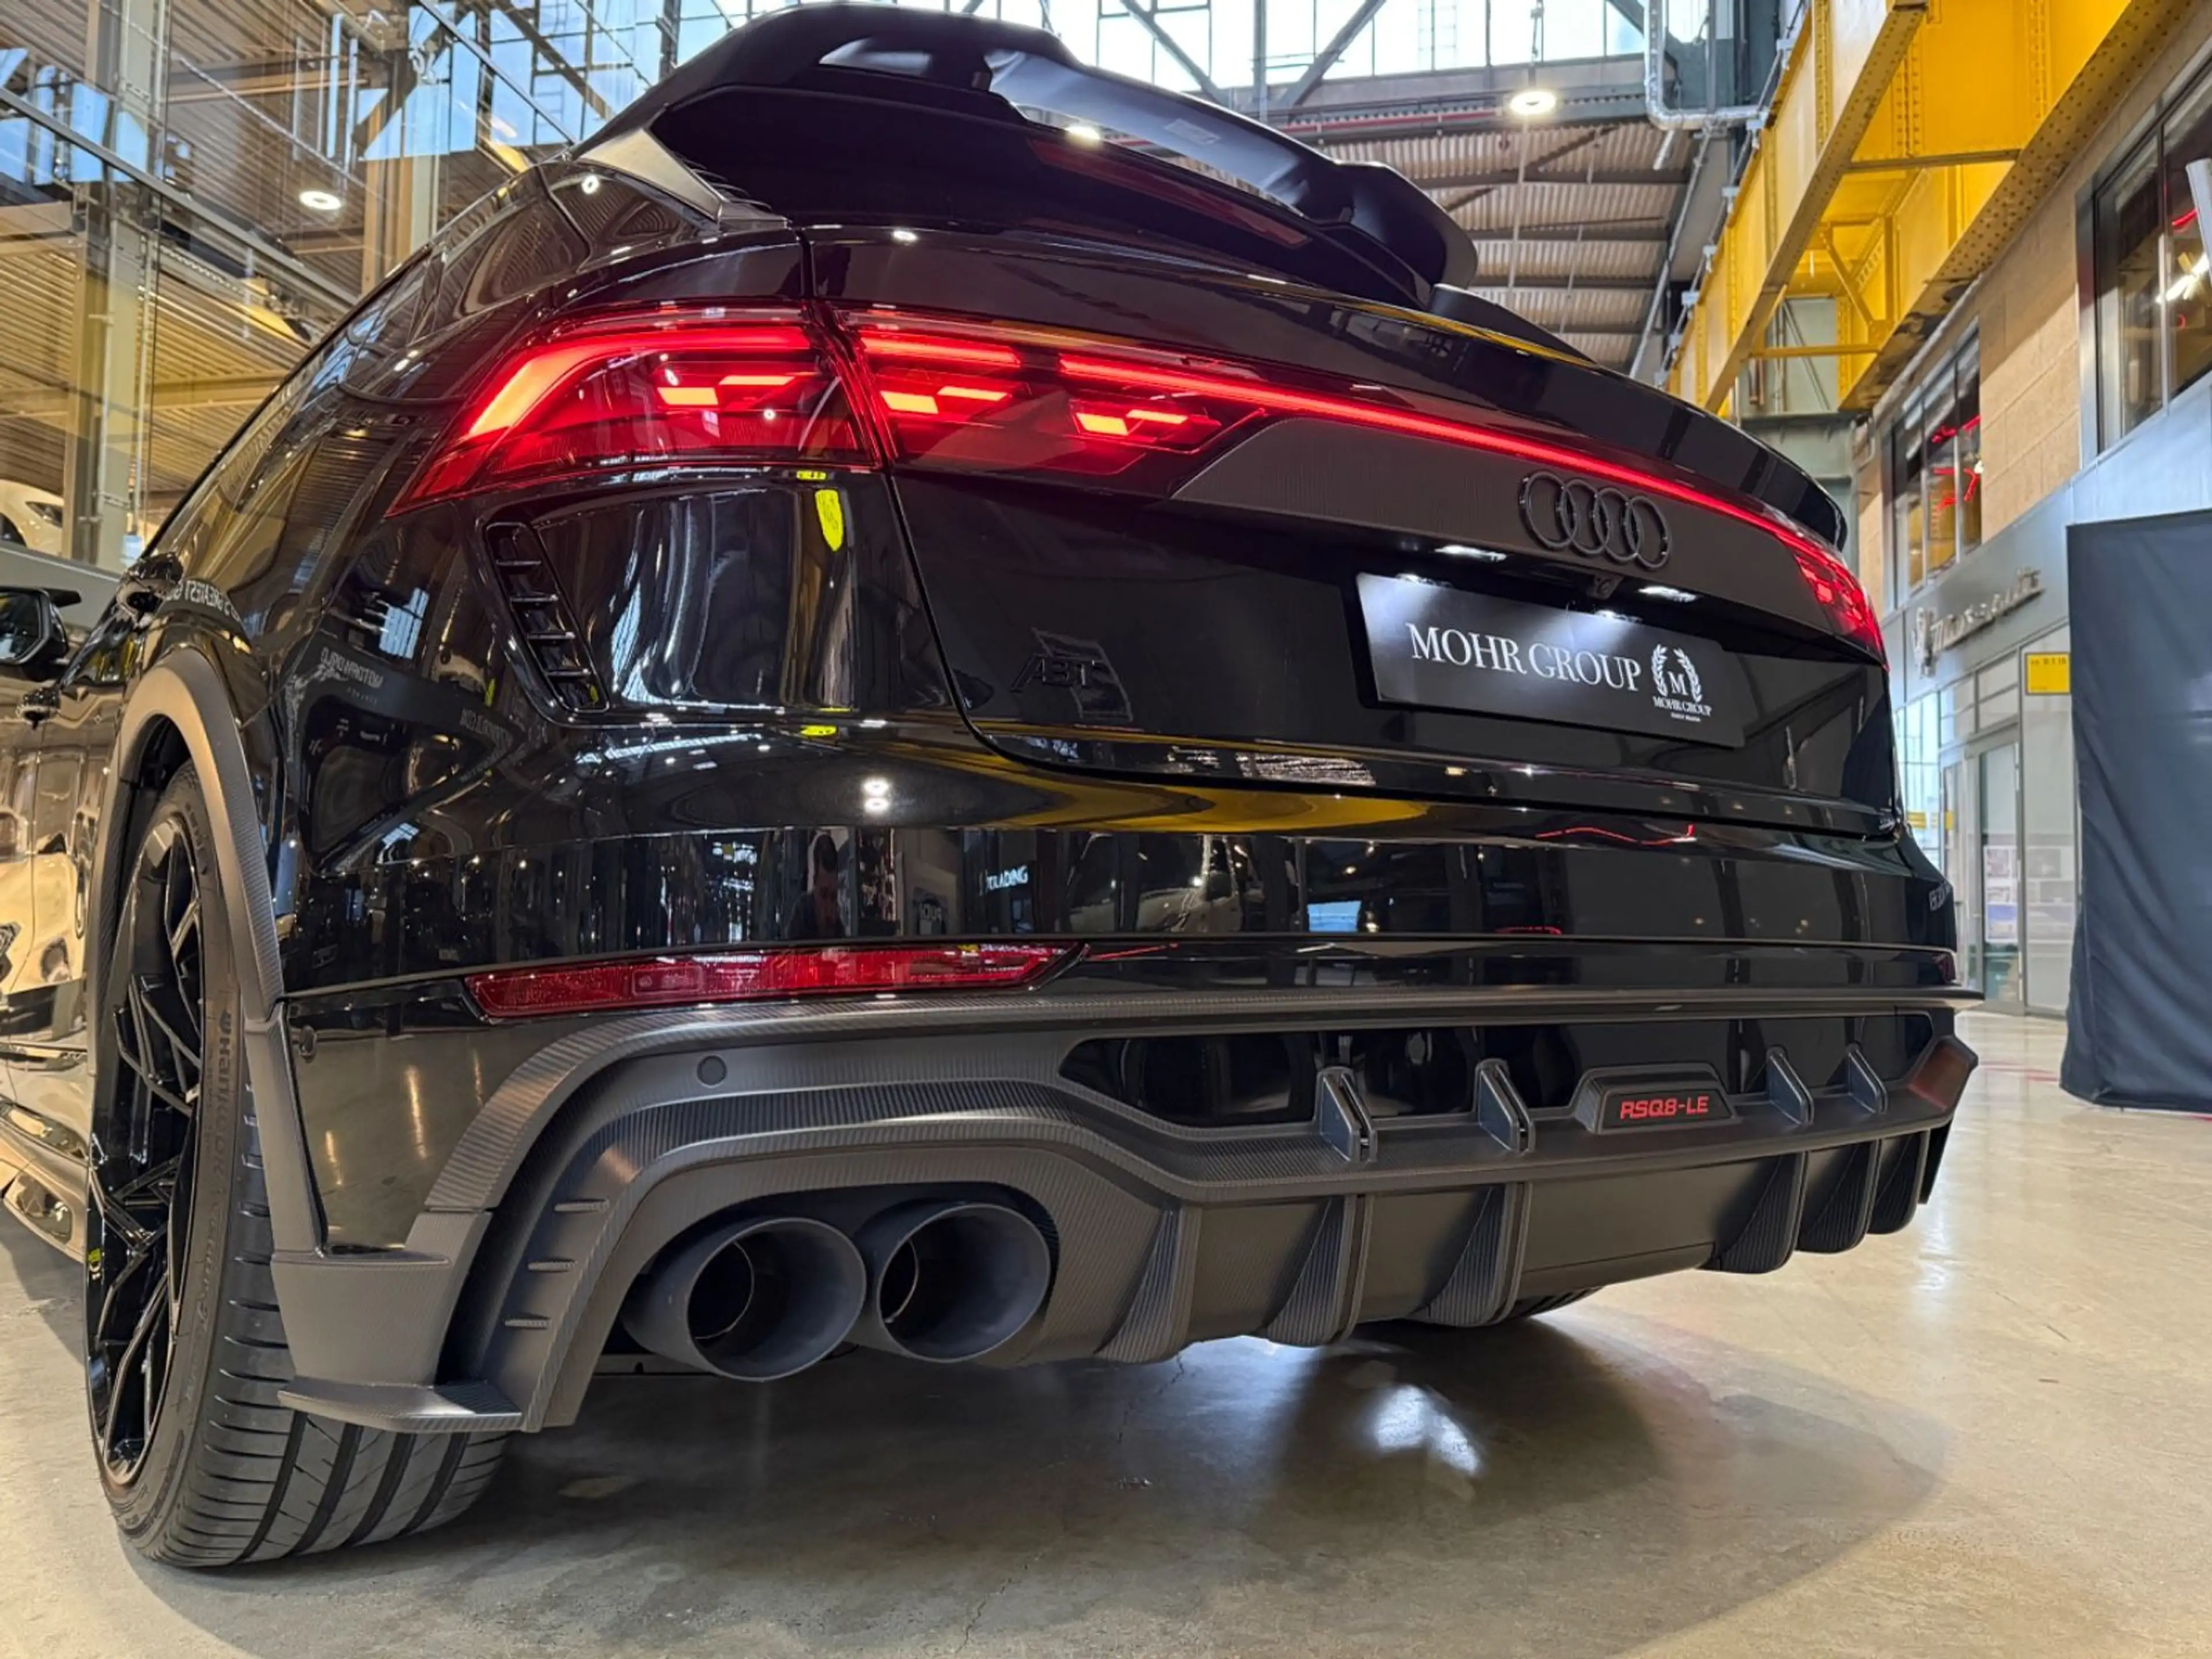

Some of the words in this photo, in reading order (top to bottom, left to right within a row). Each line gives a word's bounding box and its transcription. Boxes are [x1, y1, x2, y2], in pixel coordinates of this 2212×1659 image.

[1405, 623, 1527, 675] MOHR
[1528, 642, 1641, 691] GROUP
[1666, 671, 1689, 695] M
[1620, 1096, 1709, 1119] RSQ8-LE
